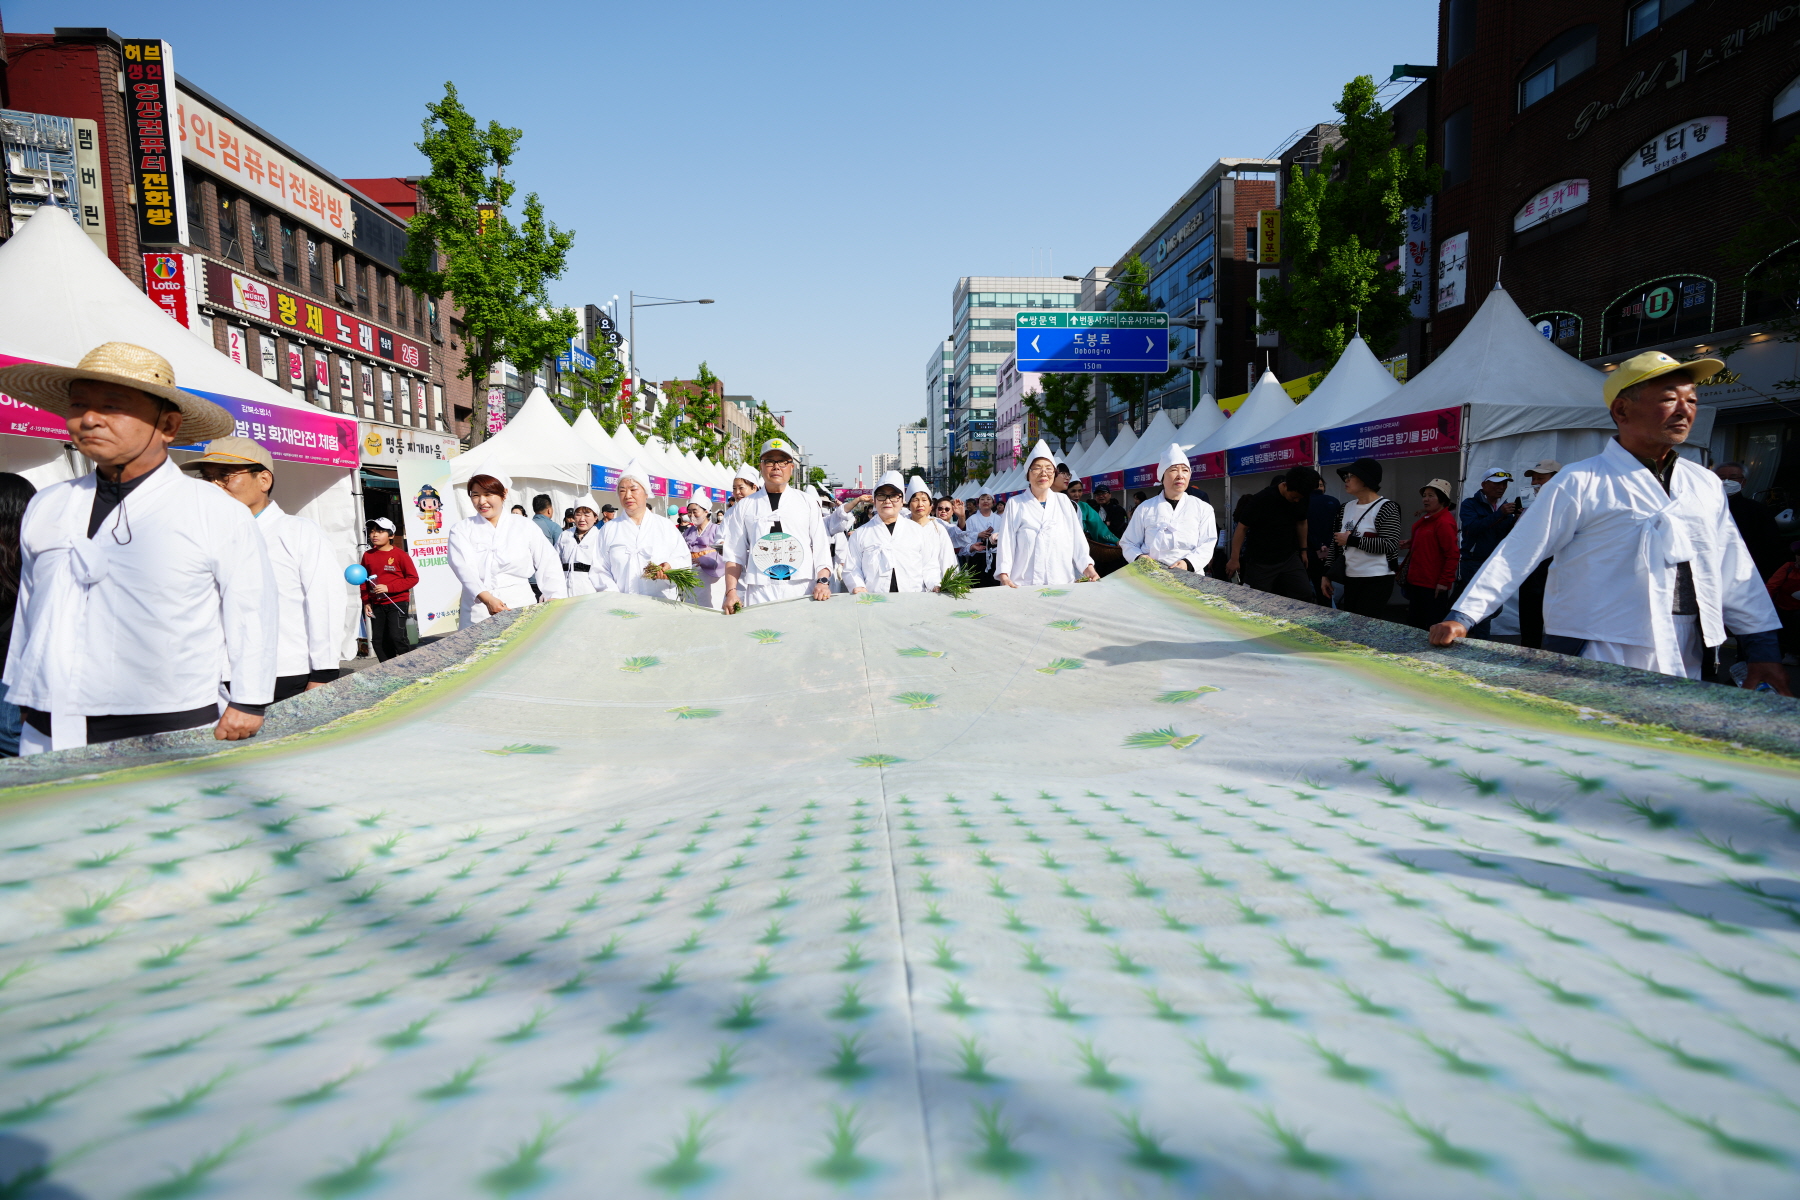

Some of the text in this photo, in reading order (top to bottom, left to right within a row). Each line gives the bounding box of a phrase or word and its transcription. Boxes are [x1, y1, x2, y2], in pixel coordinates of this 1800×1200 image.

[124, 44, 161, 62] 허브
[127, 64, 162, 80] 성인
[133, 83, 166, 172] 영상컴퓨터
[78, 128, 99, 226] 탬버린
[142, 173, 172, 226] 전화방
[1524, 181, 1579, 218] 토크카페
[341, 227, 350, 240] 3F
[1264, 216, 1276, 253] 전당포
[151, 281, 181, 290] Lotto
[1411, 268, 1422, 305] 노래방
[244, 291, 264, 303] MUSIC
[276, 292, 324, 336] 황제
[335, 314, 374, 353] 노래
[401, 343, 418, 367] 2층
[1029, 315, 1157, 327] 쌍문역 번동사거리 수유사거리
[1073, 333, 1111, 348] 도봉로
[1074, 347, 1111, 356] Dobong-ro
[1083, 362, 1102, 370] 150m
[252, 422, 267, 441] 및
[268, 425, 317, 449] 화재안전
[318, 433, 339, 451] 체험
[1330, 427, 1439, 454] 우리 모두 한마음으로 향기를 담아
[386, 437, 442, 460] 명동 찌개마을
[411, 546, 435, 558] 가족의
